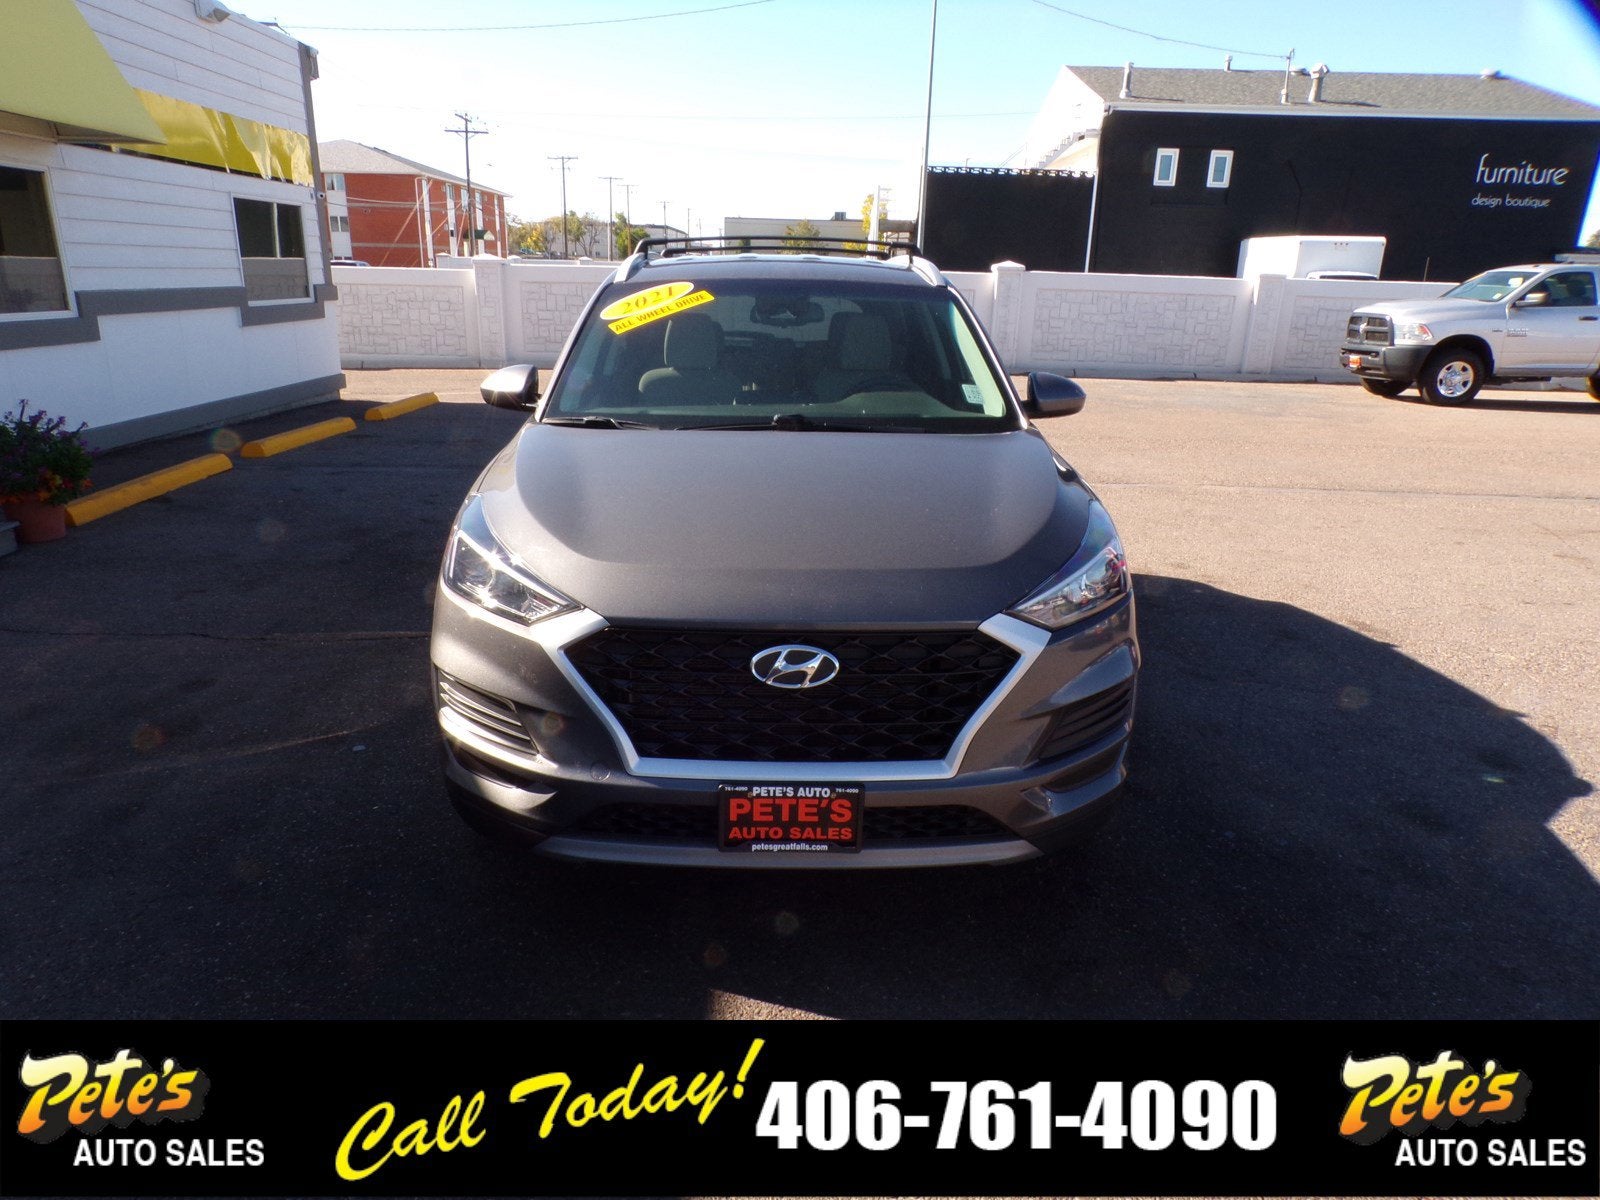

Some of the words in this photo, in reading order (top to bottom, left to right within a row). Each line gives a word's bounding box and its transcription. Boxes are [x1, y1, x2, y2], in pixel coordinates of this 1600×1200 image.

[1475, 153, 1570, 185] furniture
[1471, 193, 1502, 208] design
[1505, 193, 1551, 208] boutique
[621, 285, 674, 315] 2021
[615, 319, 635, 332] ALL
[636, 304, 672, 322] WHEEL
[675, 293, 706, 309] DRIVE
[752, 786, 795, 798] PETE'S
[797, 786, 831, 798] AUTO
[729, 798, 853, 823] PETE'S
[728, 826, 783, 840] AUTO
[789, 827, 853, 841] SALES
[751, 842, 828, 852] petesgreatfalls.com
